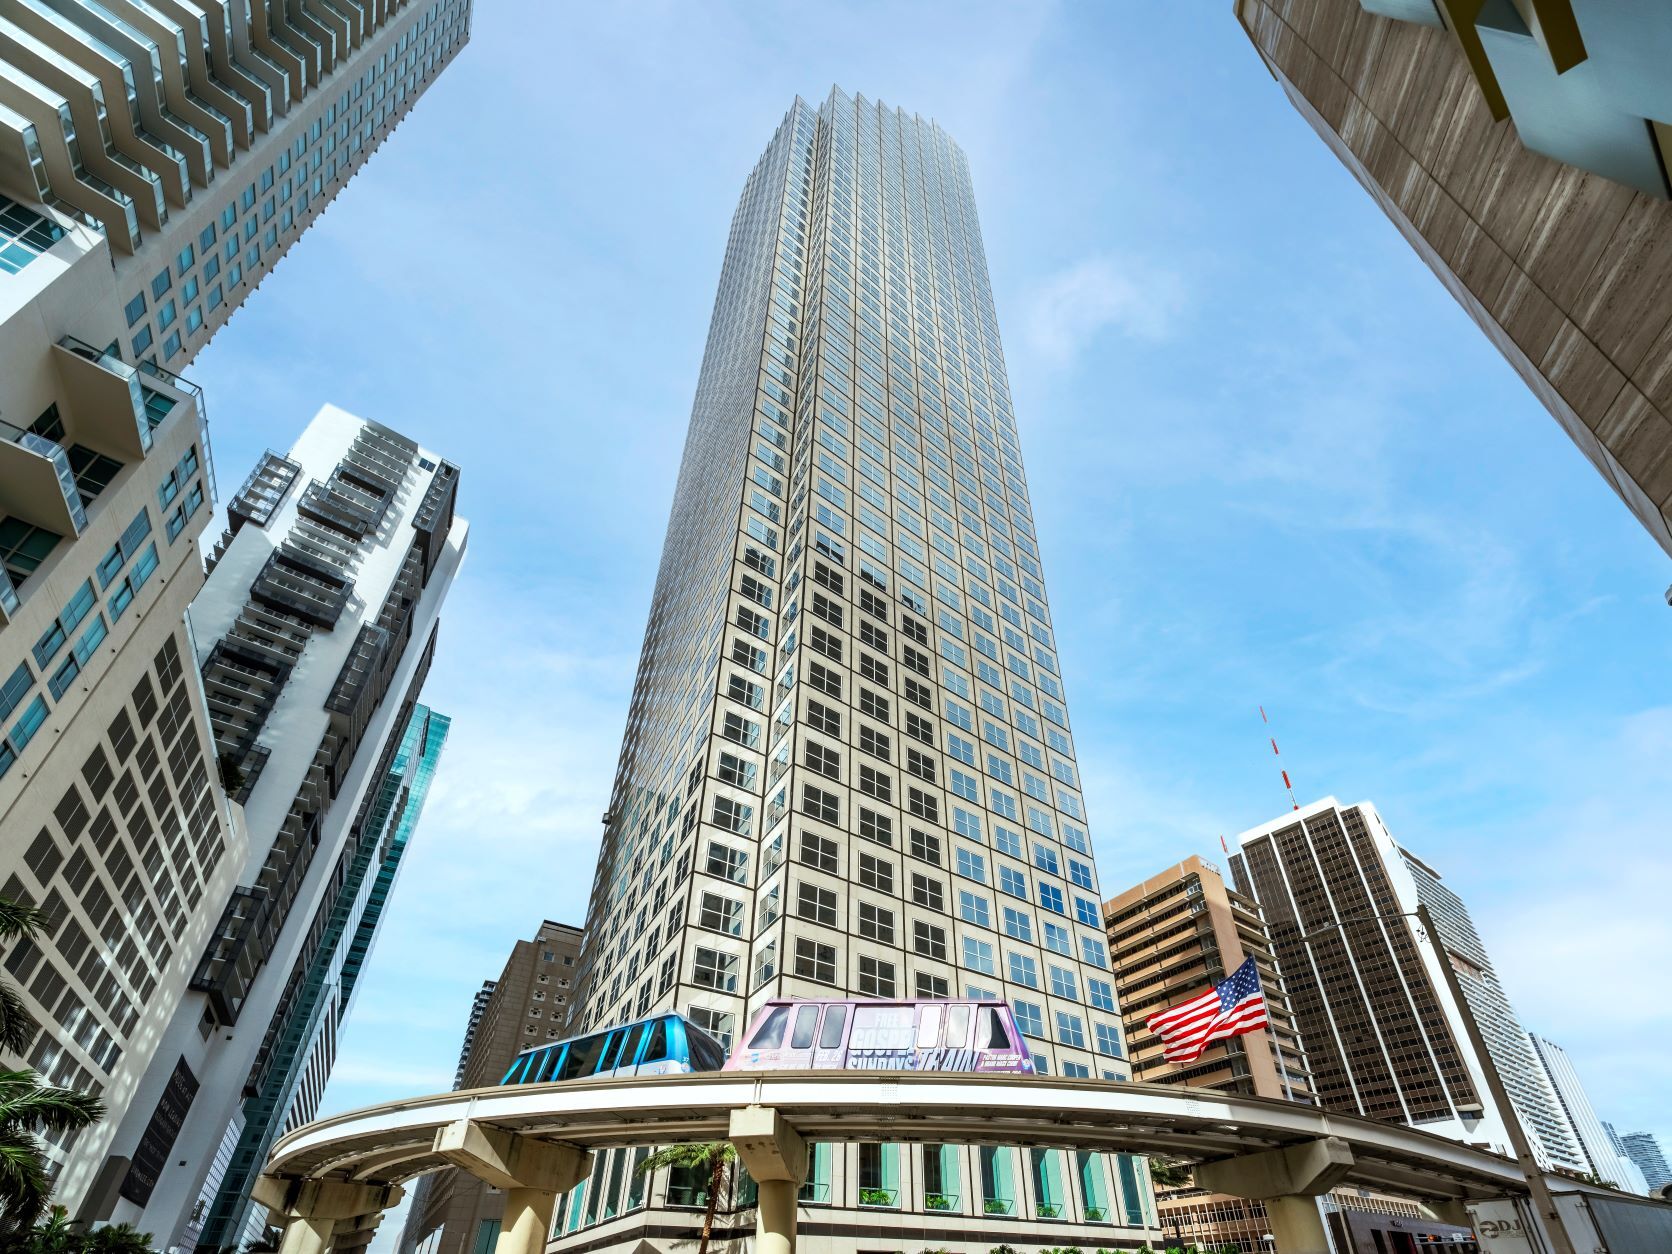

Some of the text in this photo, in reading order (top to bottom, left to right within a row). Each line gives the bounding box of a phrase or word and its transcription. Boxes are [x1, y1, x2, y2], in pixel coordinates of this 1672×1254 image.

[875, 1013, 898, 1028] FREE
[850, 1028, 915, 1056] GOSPEL
[848, 1056, 914, 1071] SUNDAYS
[917, 1049, 981, 1072] TRAIN
